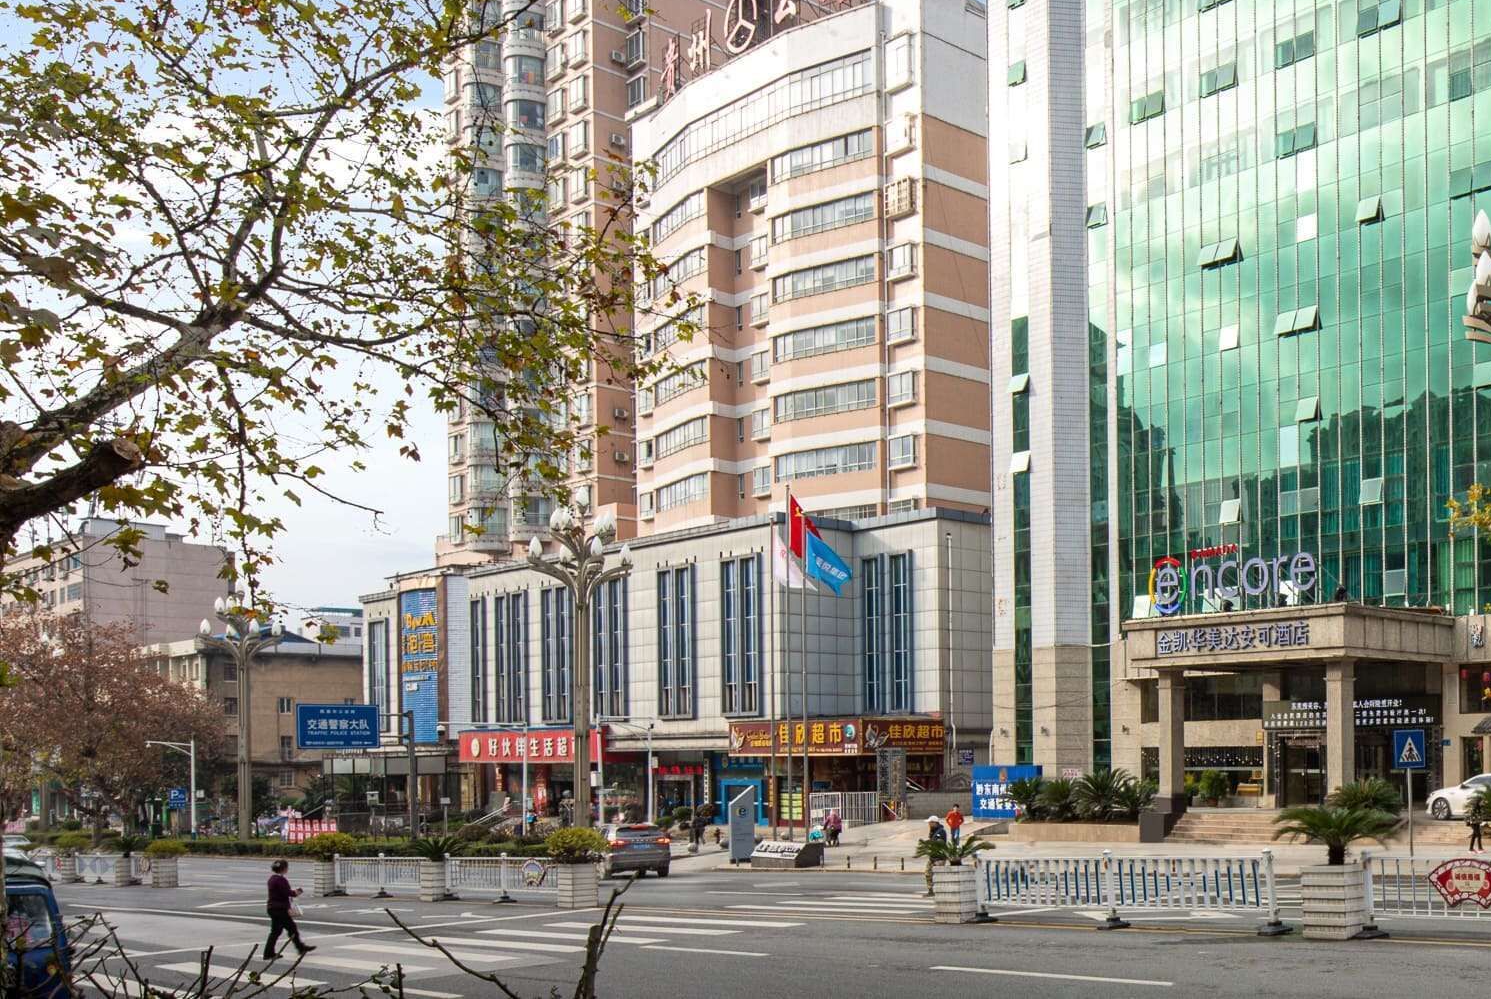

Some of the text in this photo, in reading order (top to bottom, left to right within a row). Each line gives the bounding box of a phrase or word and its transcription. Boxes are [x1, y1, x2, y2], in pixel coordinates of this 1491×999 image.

[1157, 552, 1316, 605] encore
[306, 718, 370, 730] 交通警察大队
[888, 724, 945, 740] 佳欣超市
[488, 736, 575, 757] 好伙伴生活超
